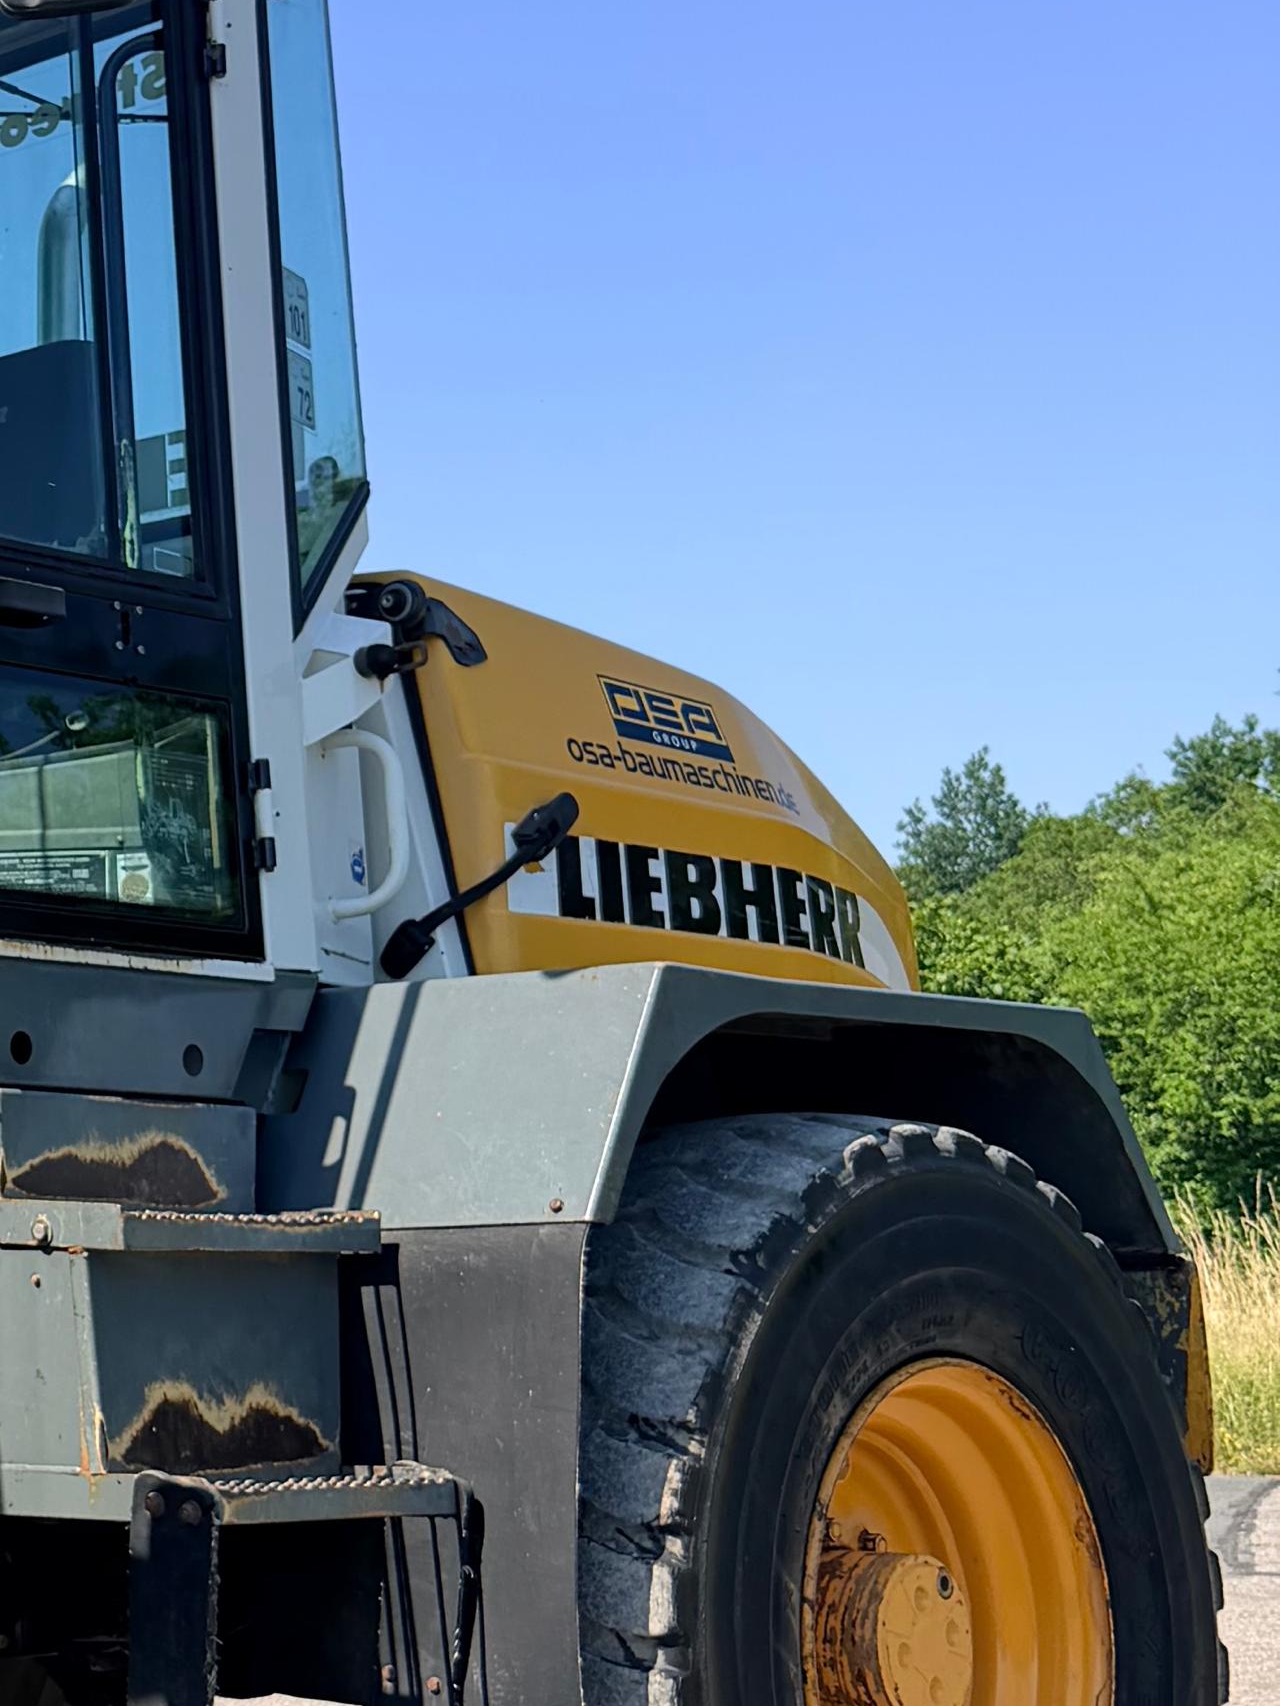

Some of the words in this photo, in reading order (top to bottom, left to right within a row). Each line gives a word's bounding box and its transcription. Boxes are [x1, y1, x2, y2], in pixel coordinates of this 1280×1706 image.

[289, 304, 307, 341] 101
[297, 387, 313, 420] 72
[652, 730, 697, 751] GROUP
[567, 738, 800, 816] osa-baumaschinen.de
[556, 834, 866, 970] LIEBHERR
